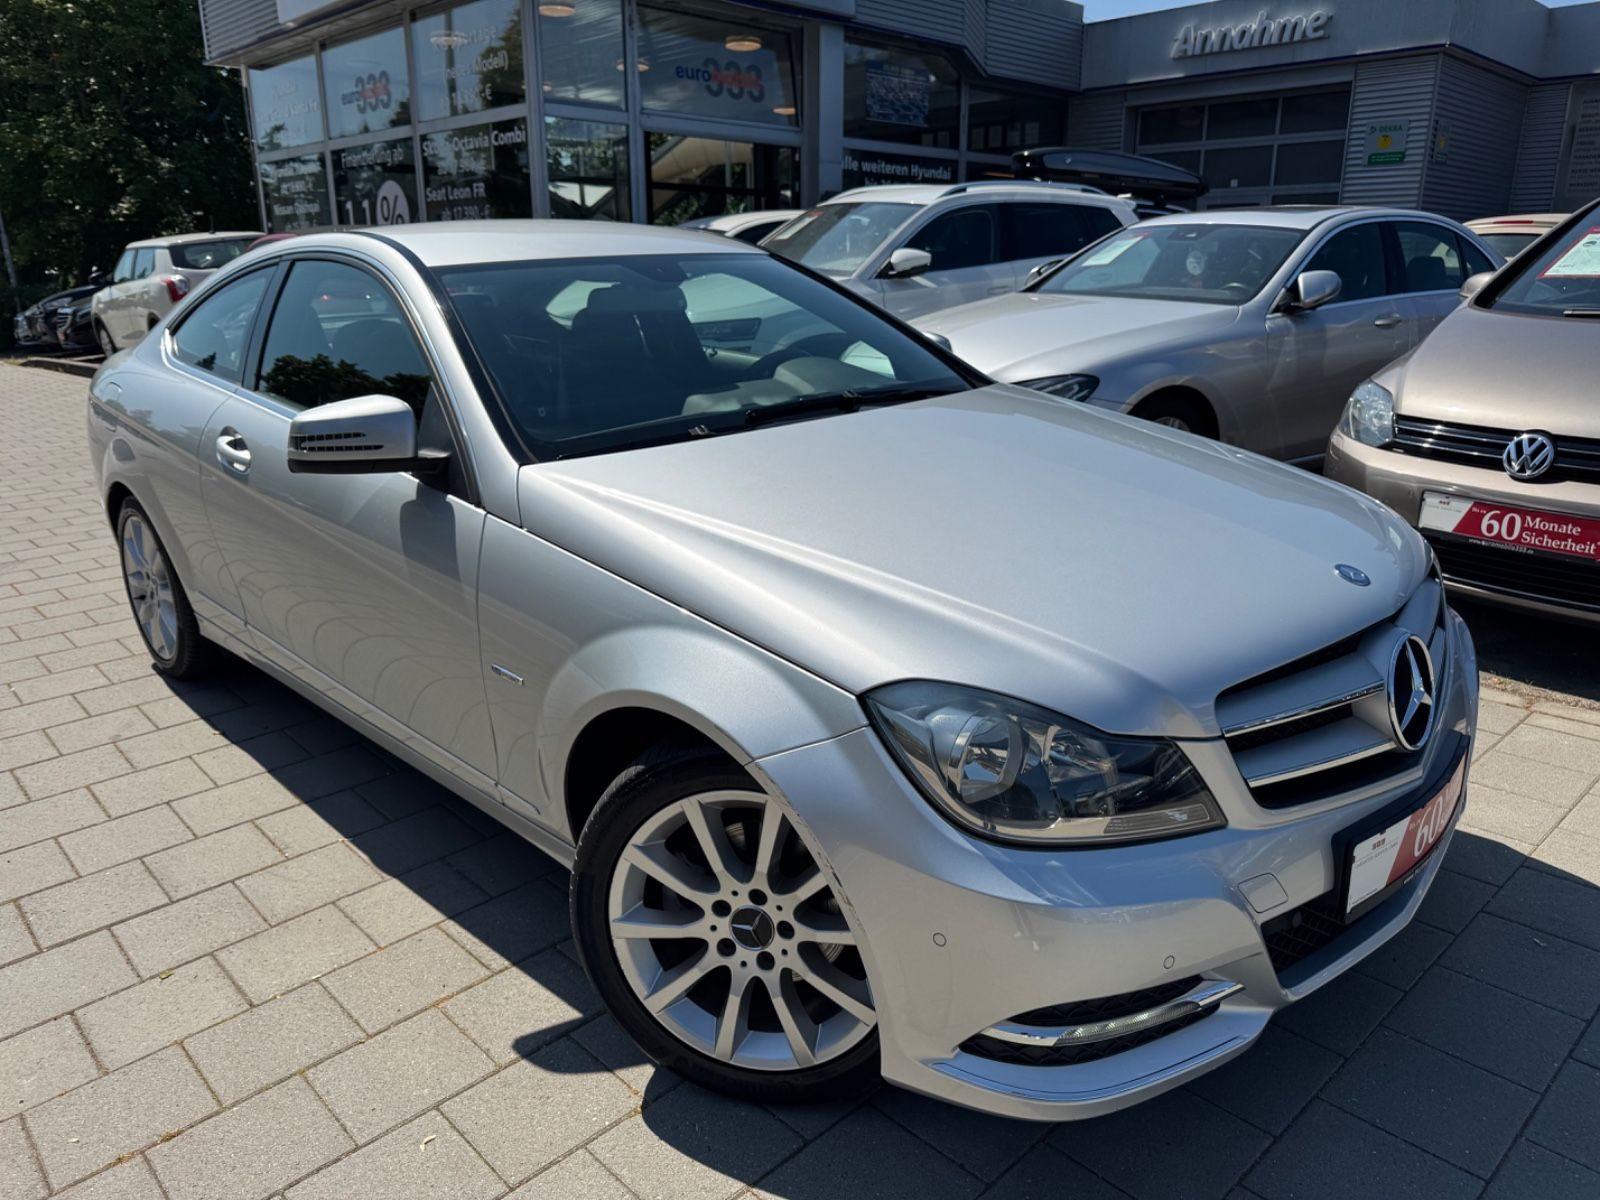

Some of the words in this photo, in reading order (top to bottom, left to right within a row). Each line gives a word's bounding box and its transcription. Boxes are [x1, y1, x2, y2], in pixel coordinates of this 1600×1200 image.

[1171, 8, 1332, 59] Annahme
[675, 65, 712, 82] euro
[453, 132, 489, 151] Octavia
[491, 126, 526, 146] Combi
[841, 155, 859, 170] lle
[861, 160, 909, 176] weiteren
[911, 164, 952, 181] Hyundai
[426, 187, 447, 202] Seat
[447, 185, 472, 200] Leon
[473, 182, 486, 198] FR
[1481, 510, 1521, 541] 60
[1524, 515, 1581, 536] Monate
[1414, 796, 1443, 857] 60
